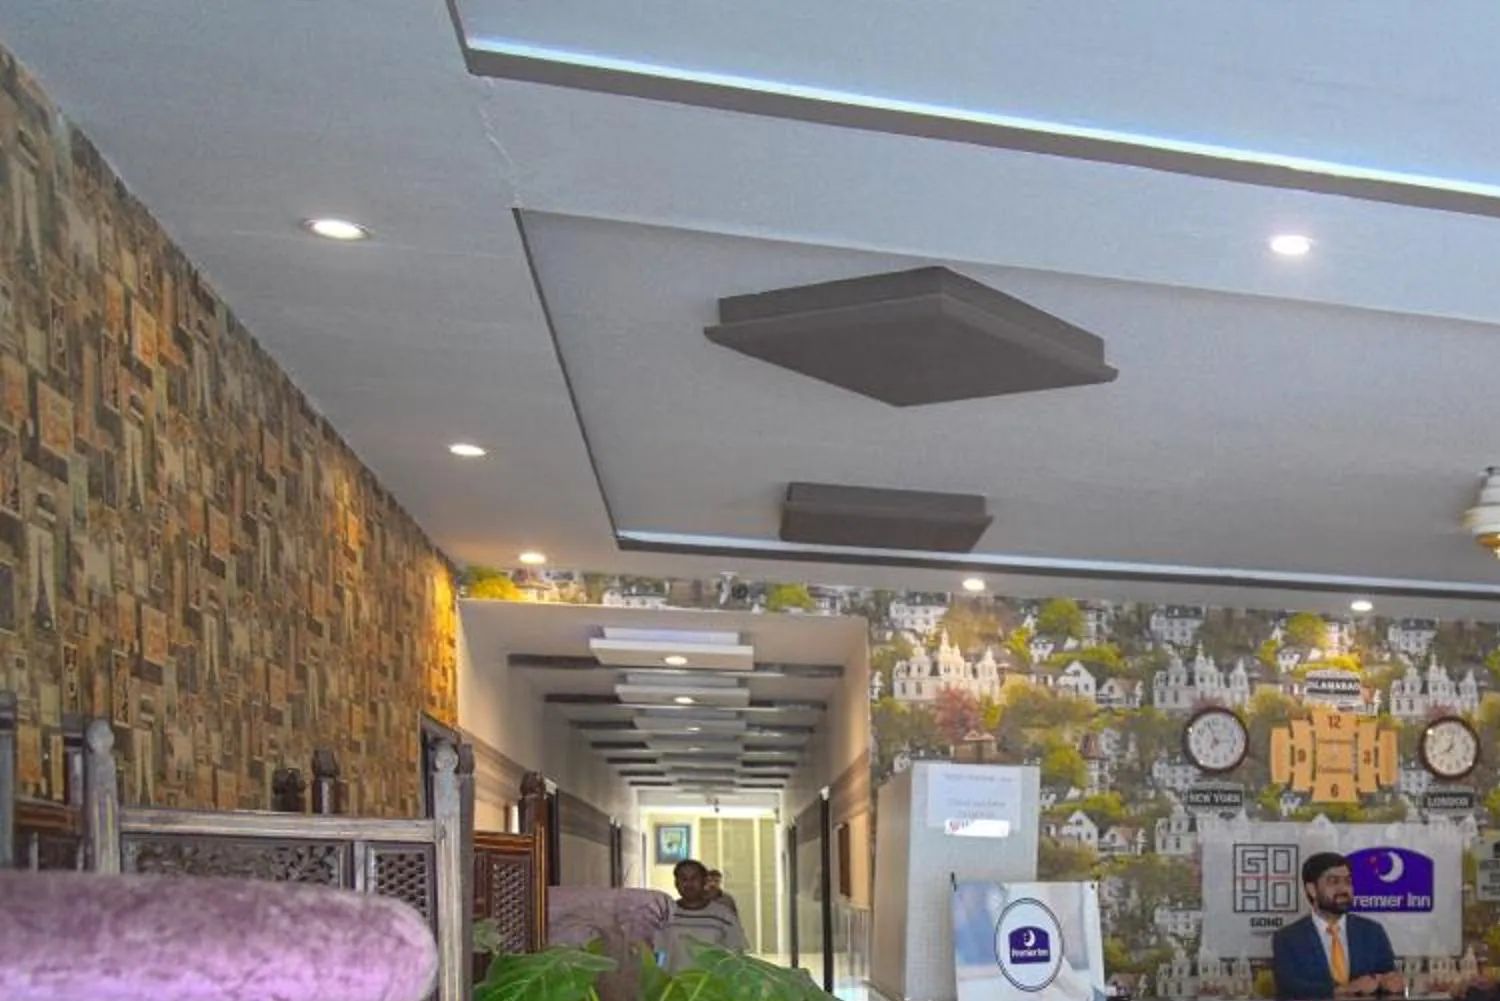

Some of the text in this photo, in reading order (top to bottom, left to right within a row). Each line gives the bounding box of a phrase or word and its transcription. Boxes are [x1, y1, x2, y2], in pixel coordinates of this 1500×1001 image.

[1328, 715, 1341, 729] 12
[1330, 784, 1339, 798] 6
[1189, 793, 1241, 804] NEW YORK
[1352, 891, 1431, 908] remier Inn
